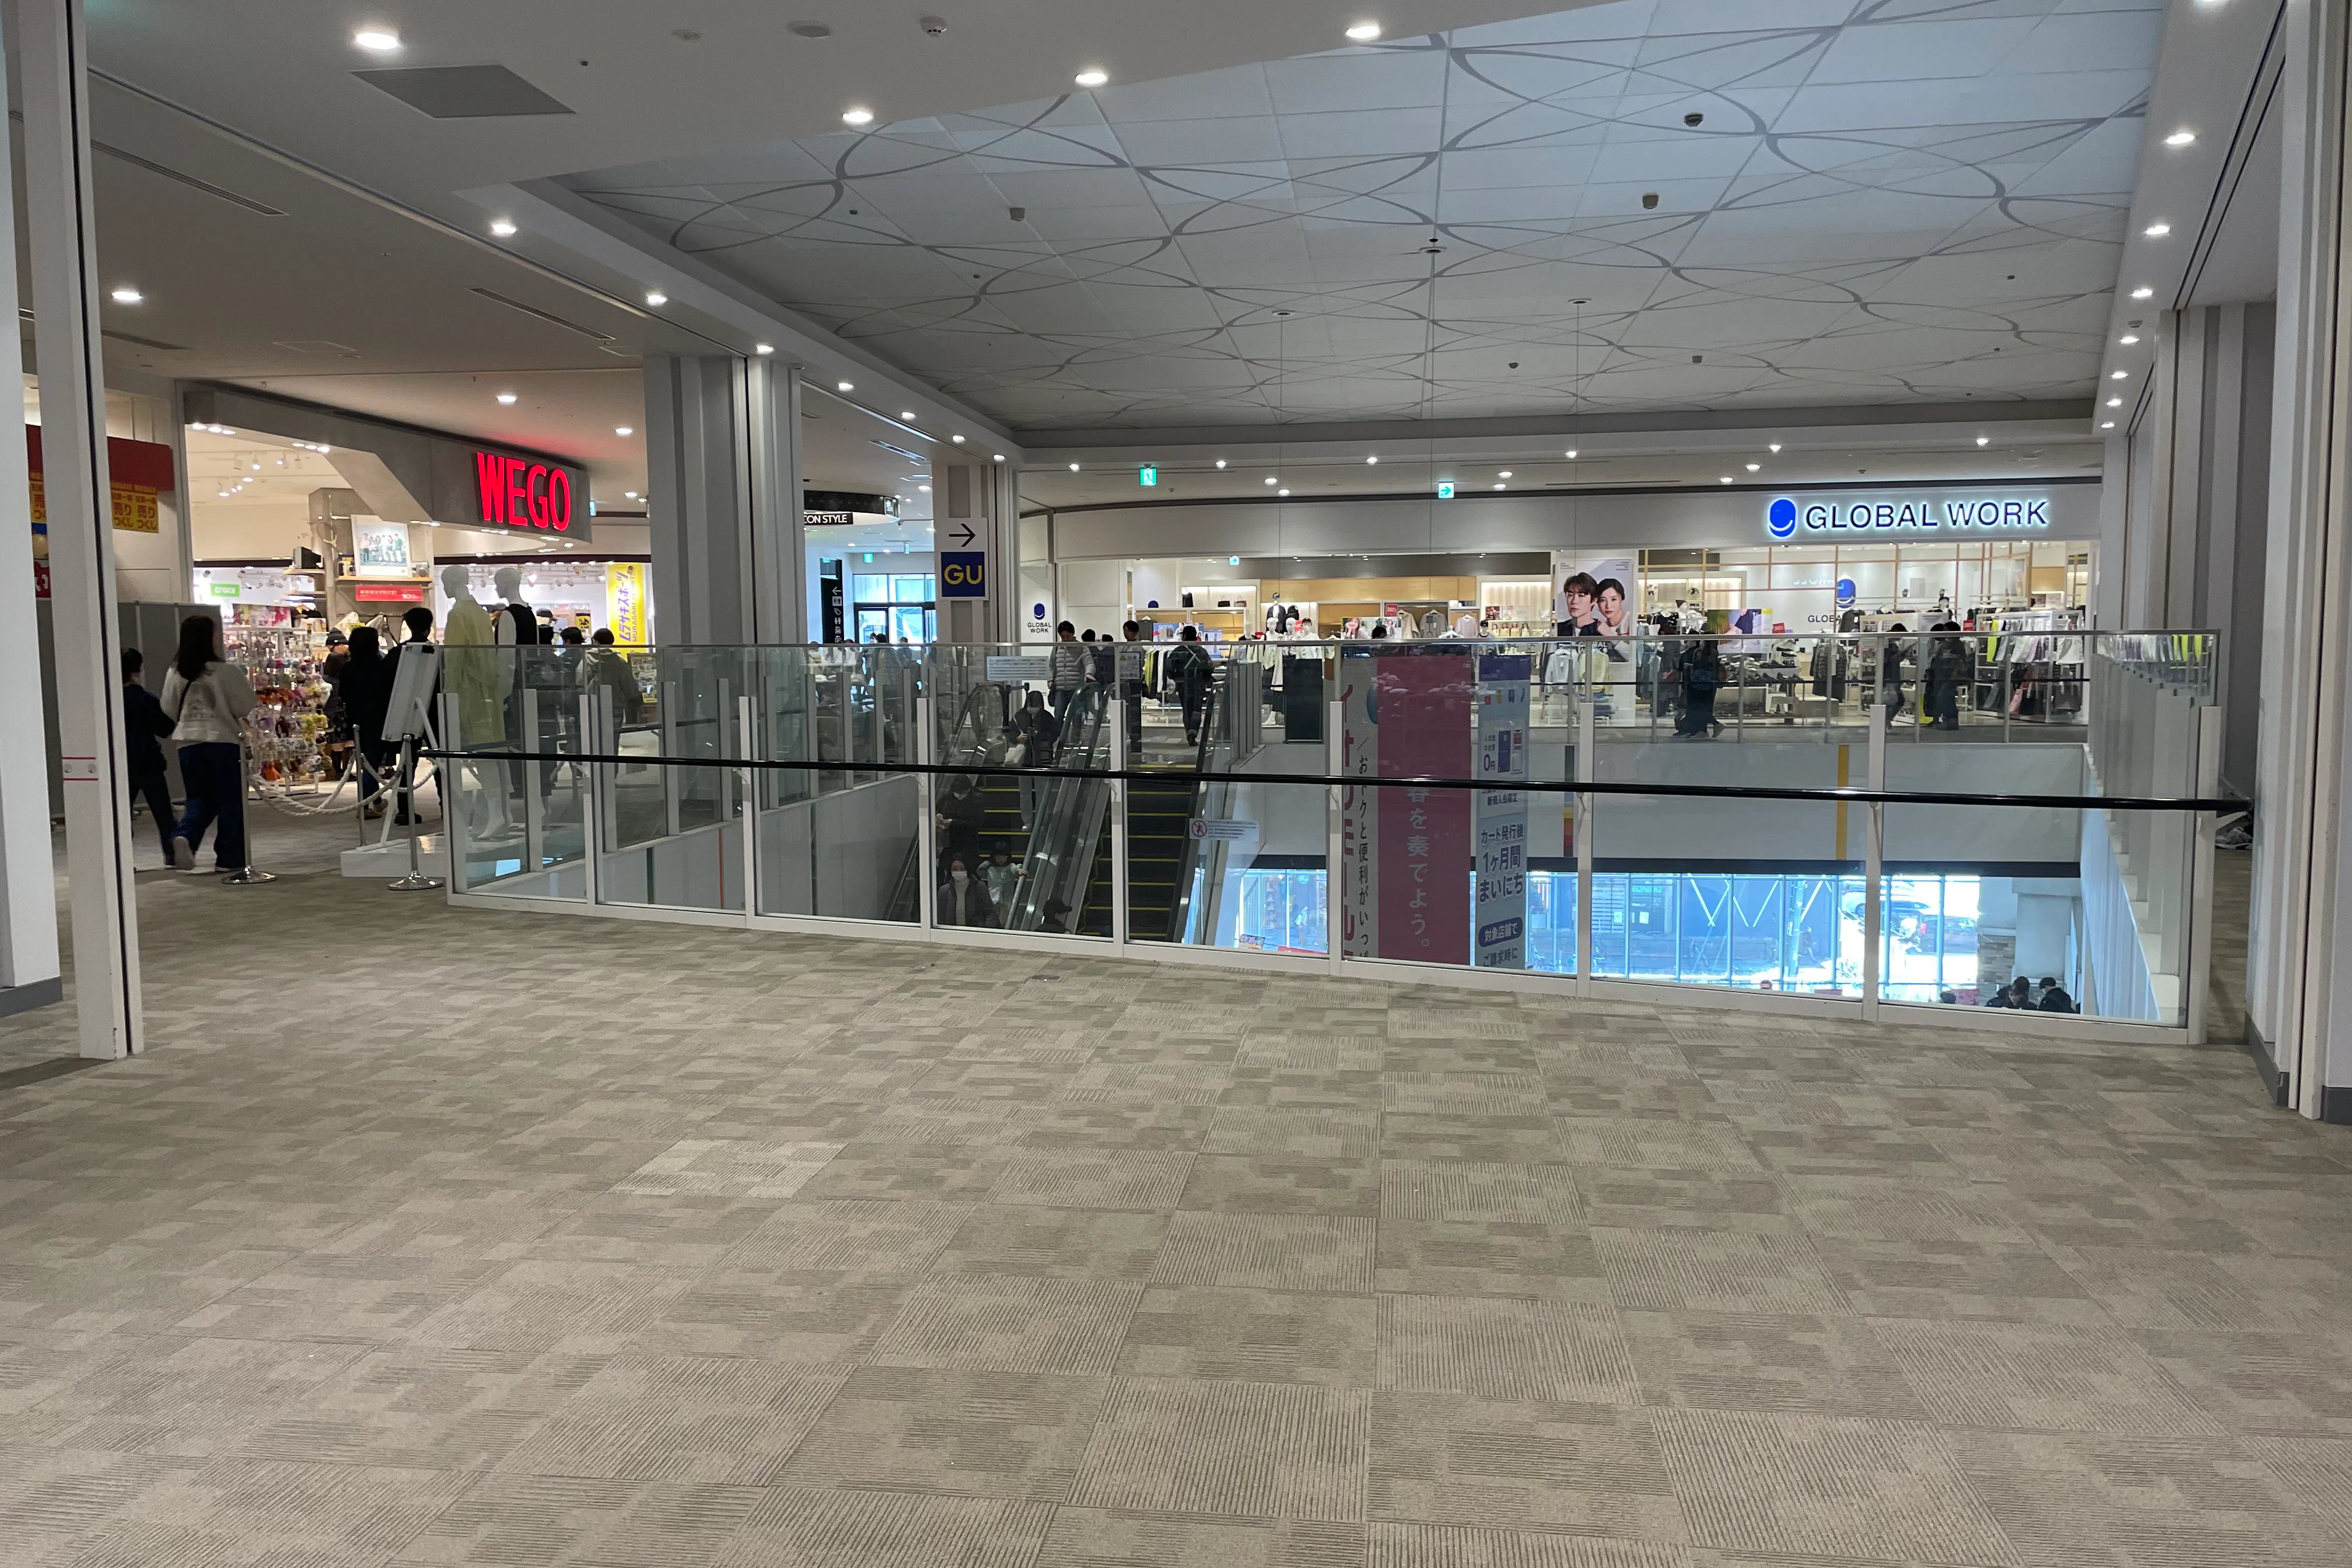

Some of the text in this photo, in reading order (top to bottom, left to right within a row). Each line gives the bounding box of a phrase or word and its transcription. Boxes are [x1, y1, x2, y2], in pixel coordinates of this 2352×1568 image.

[477, 452, 570, 531] WEGO
[822, 514, 848, 524] STYLE
[1805, 500, 2048, 529] GLOBAL WORK
[944, 564, 982, 584] GU
[616, 571, 631, 642] ムラサキスポーツ
[1480, 823, 1524, 844] カード発行後
[1479, 872, 1524, 903] まいにち
